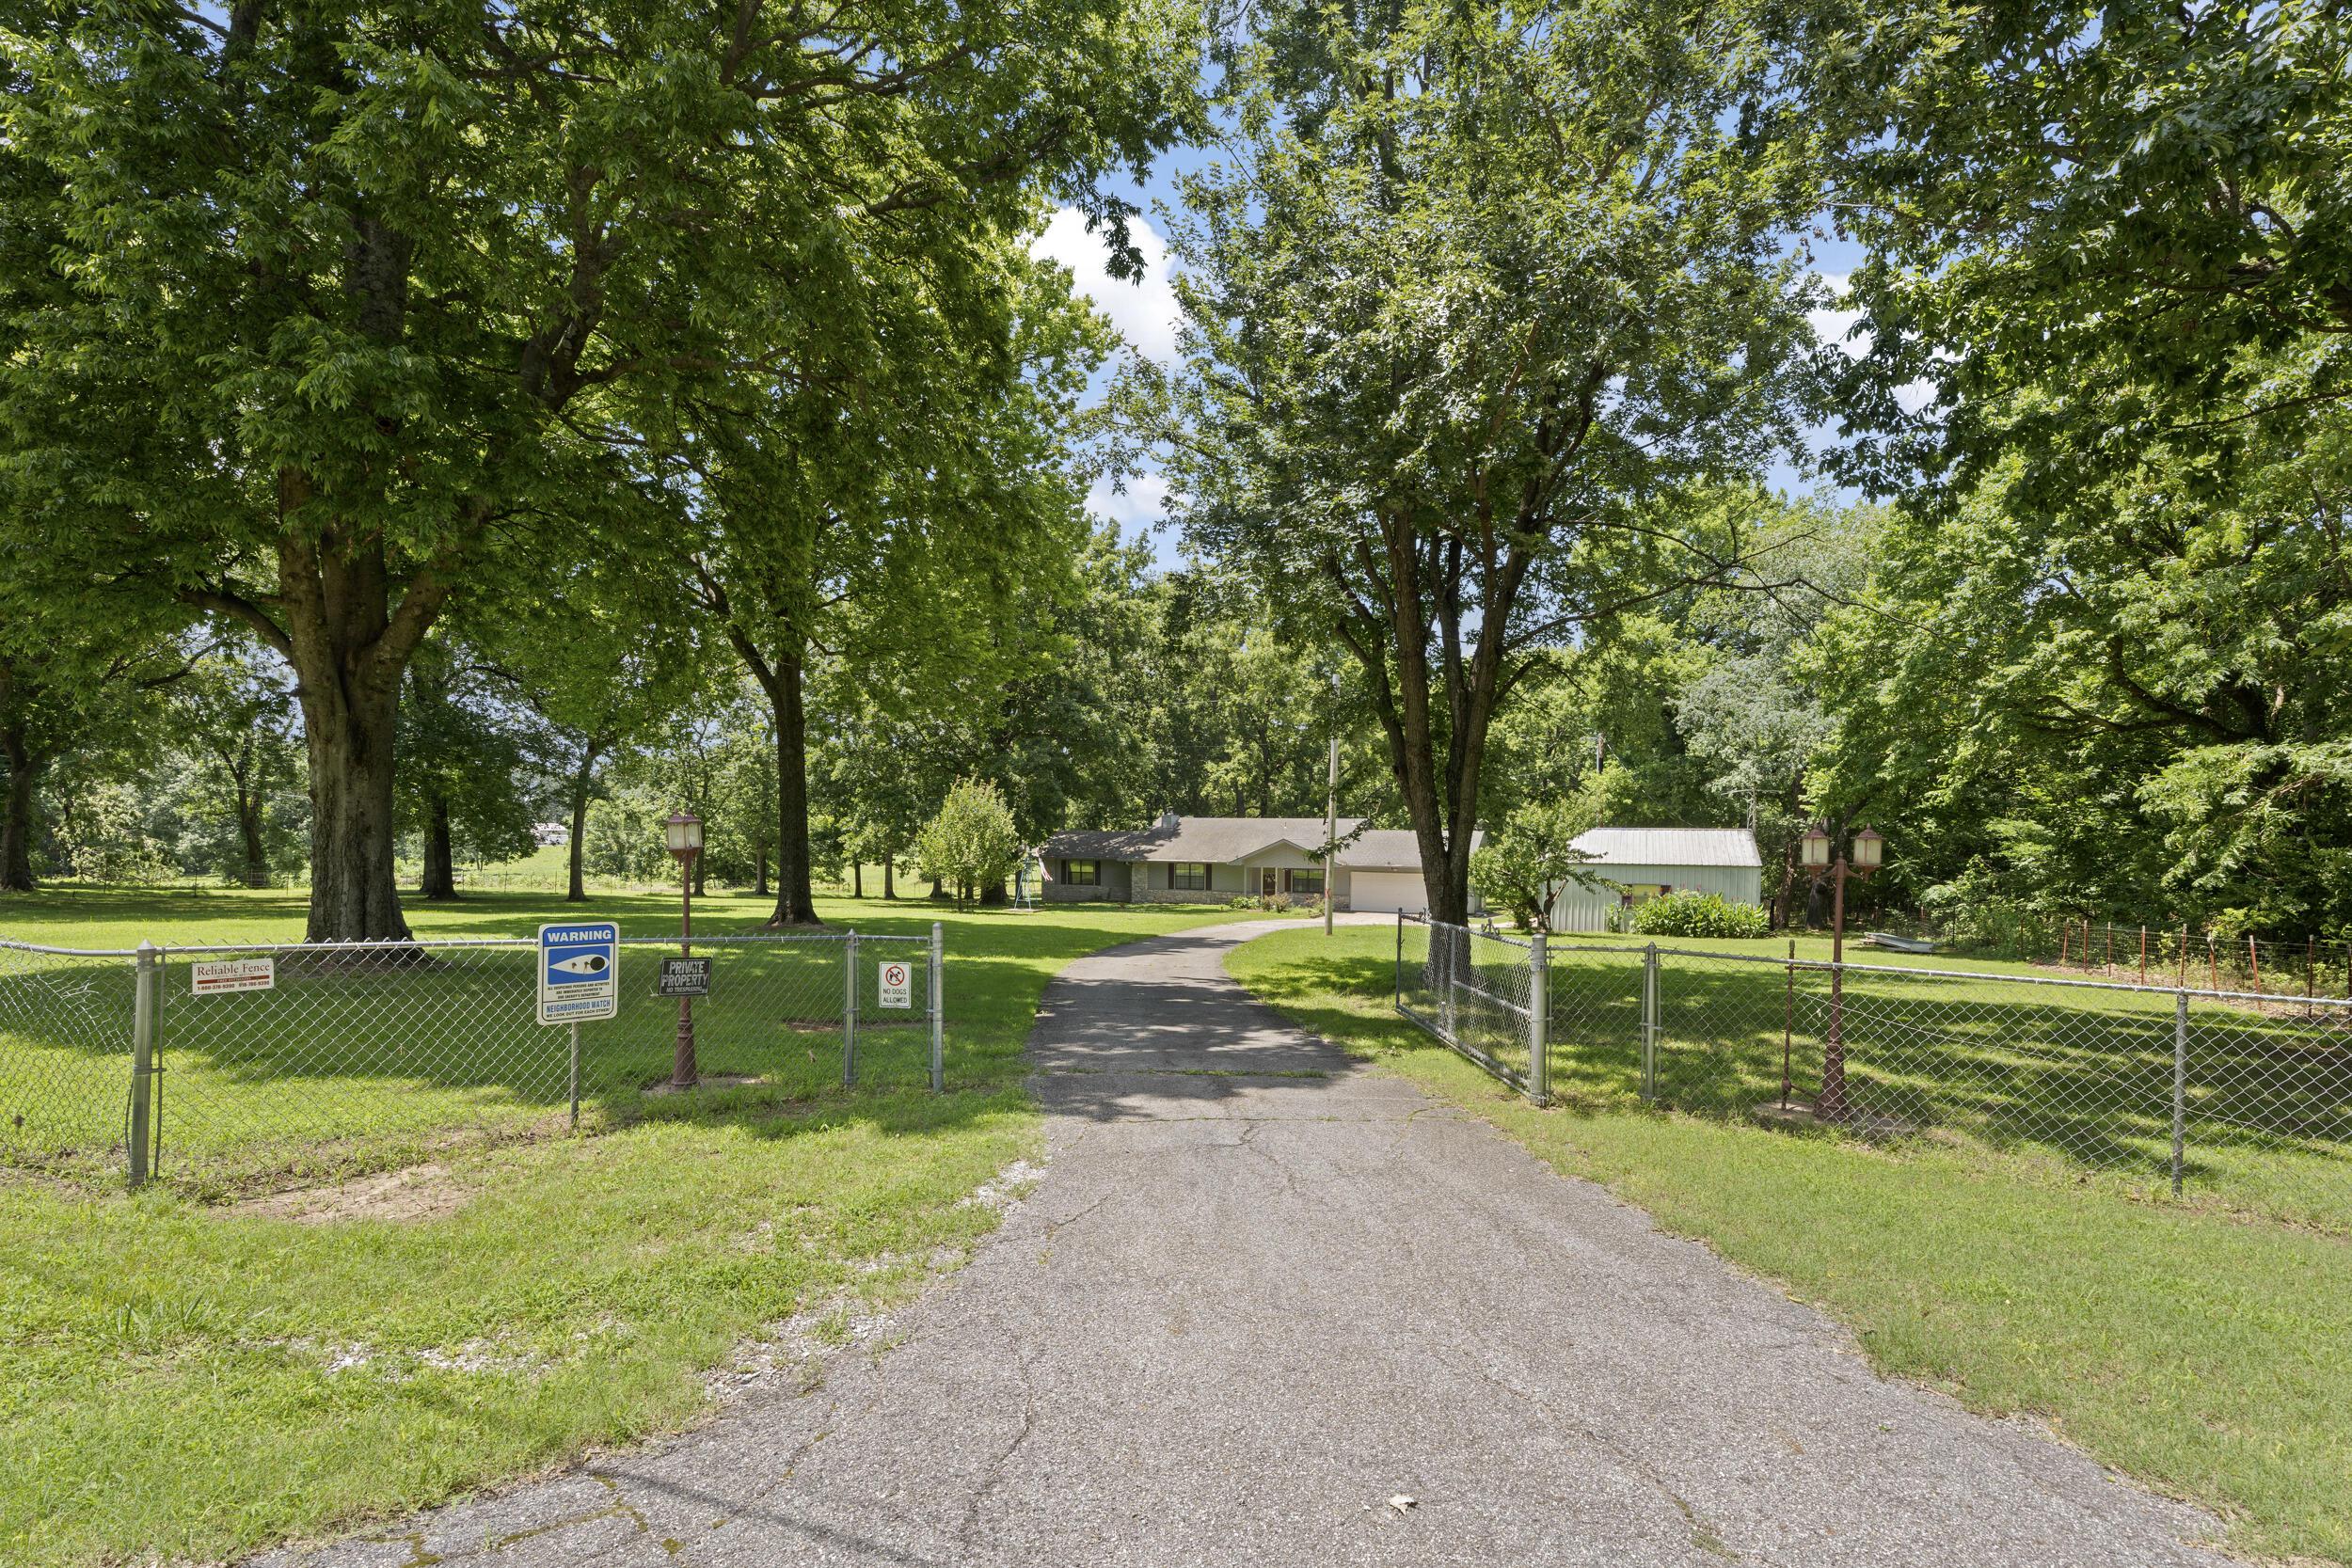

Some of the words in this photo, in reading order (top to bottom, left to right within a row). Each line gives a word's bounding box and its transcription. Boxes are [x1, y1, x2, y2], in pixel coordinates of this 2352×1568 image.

[548, 930, 612, 942] WARNING
[197, 964, 239, 976] Reliable
[242, 963, 270, 973] Fence
[669, 961, 705, 974] PRIVATE
[661, 973, 708, 986] PROPERTY
[546, 1002, 590, 1013] NEIGHBORHOOD
[591, 999, 611, 1008] WATCH
